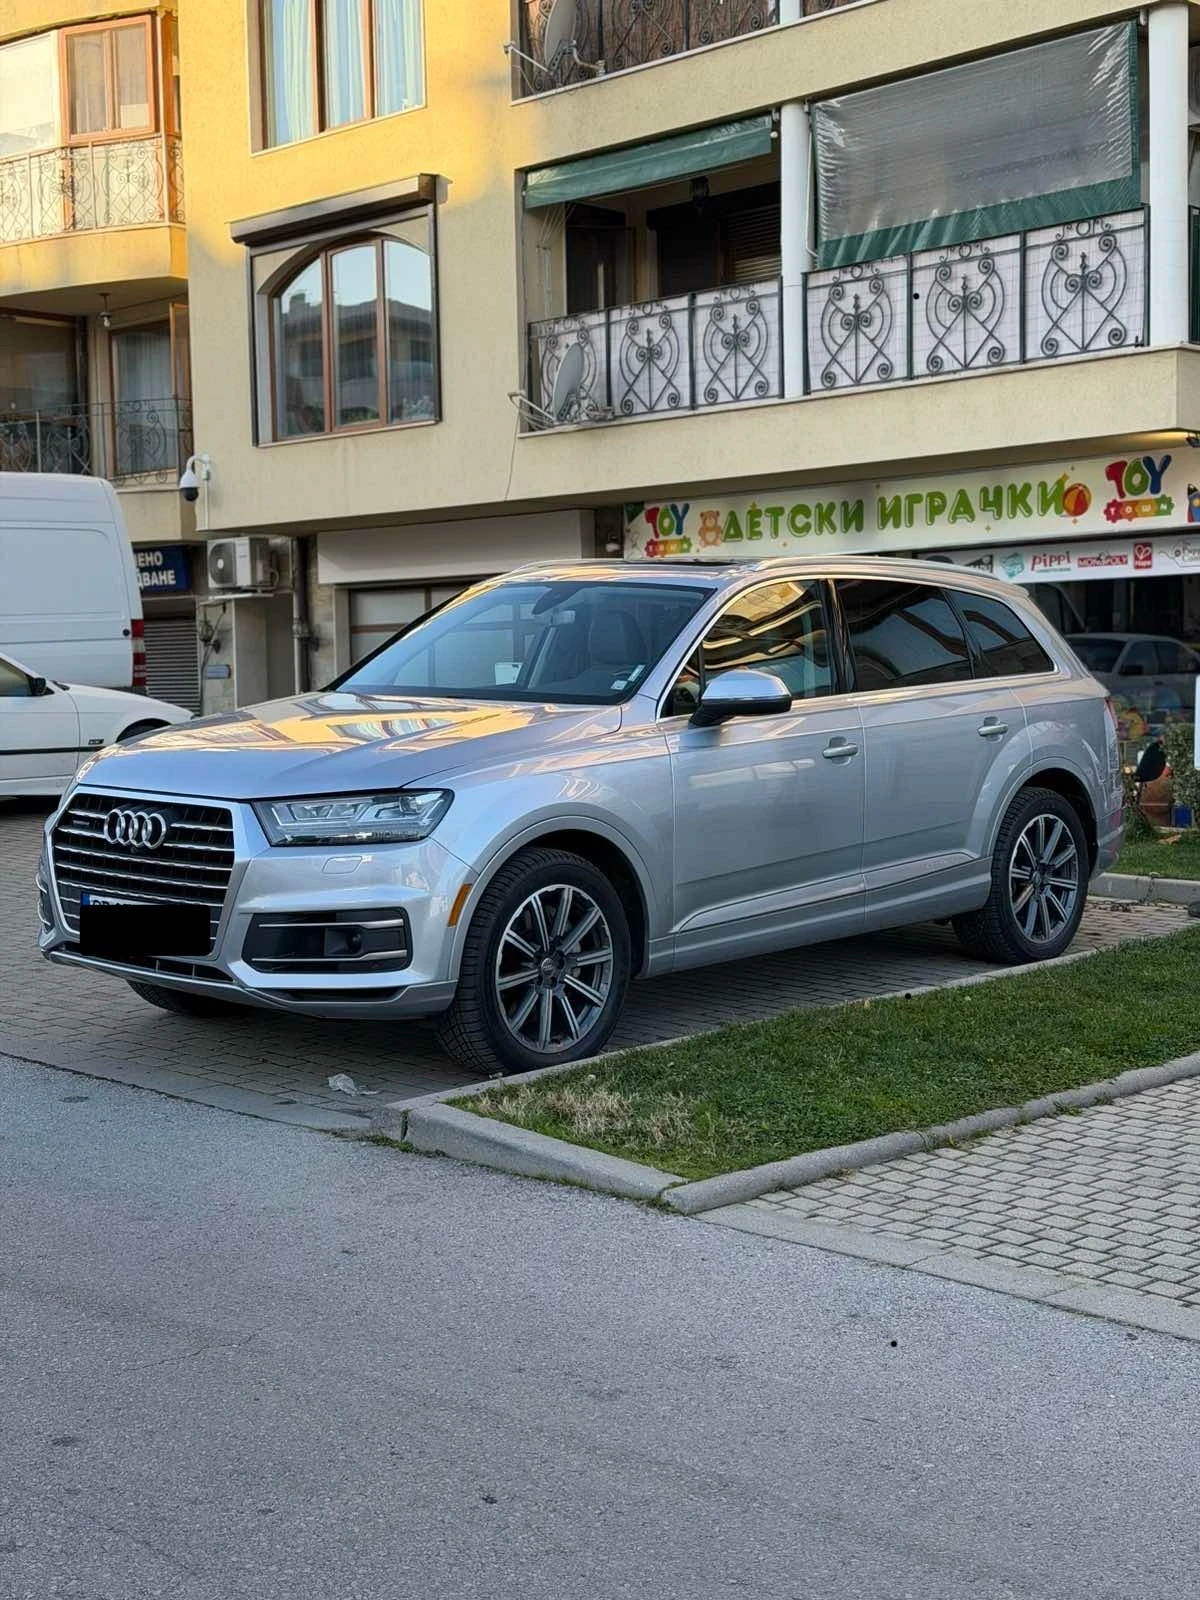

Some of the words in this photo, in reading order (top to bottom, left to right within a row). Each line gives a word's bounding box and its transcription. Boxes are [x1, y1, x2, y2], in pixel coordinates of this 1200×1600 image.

[1105, 455, 1172, 498] TOY
[645, 503, 690, 538] TOY
[723, 500, 864, 543] ДЕТСКИ
[877, 480, 1066, 528] ИГРАЧКИ
[134, 551, 163, 567] ЕНО
